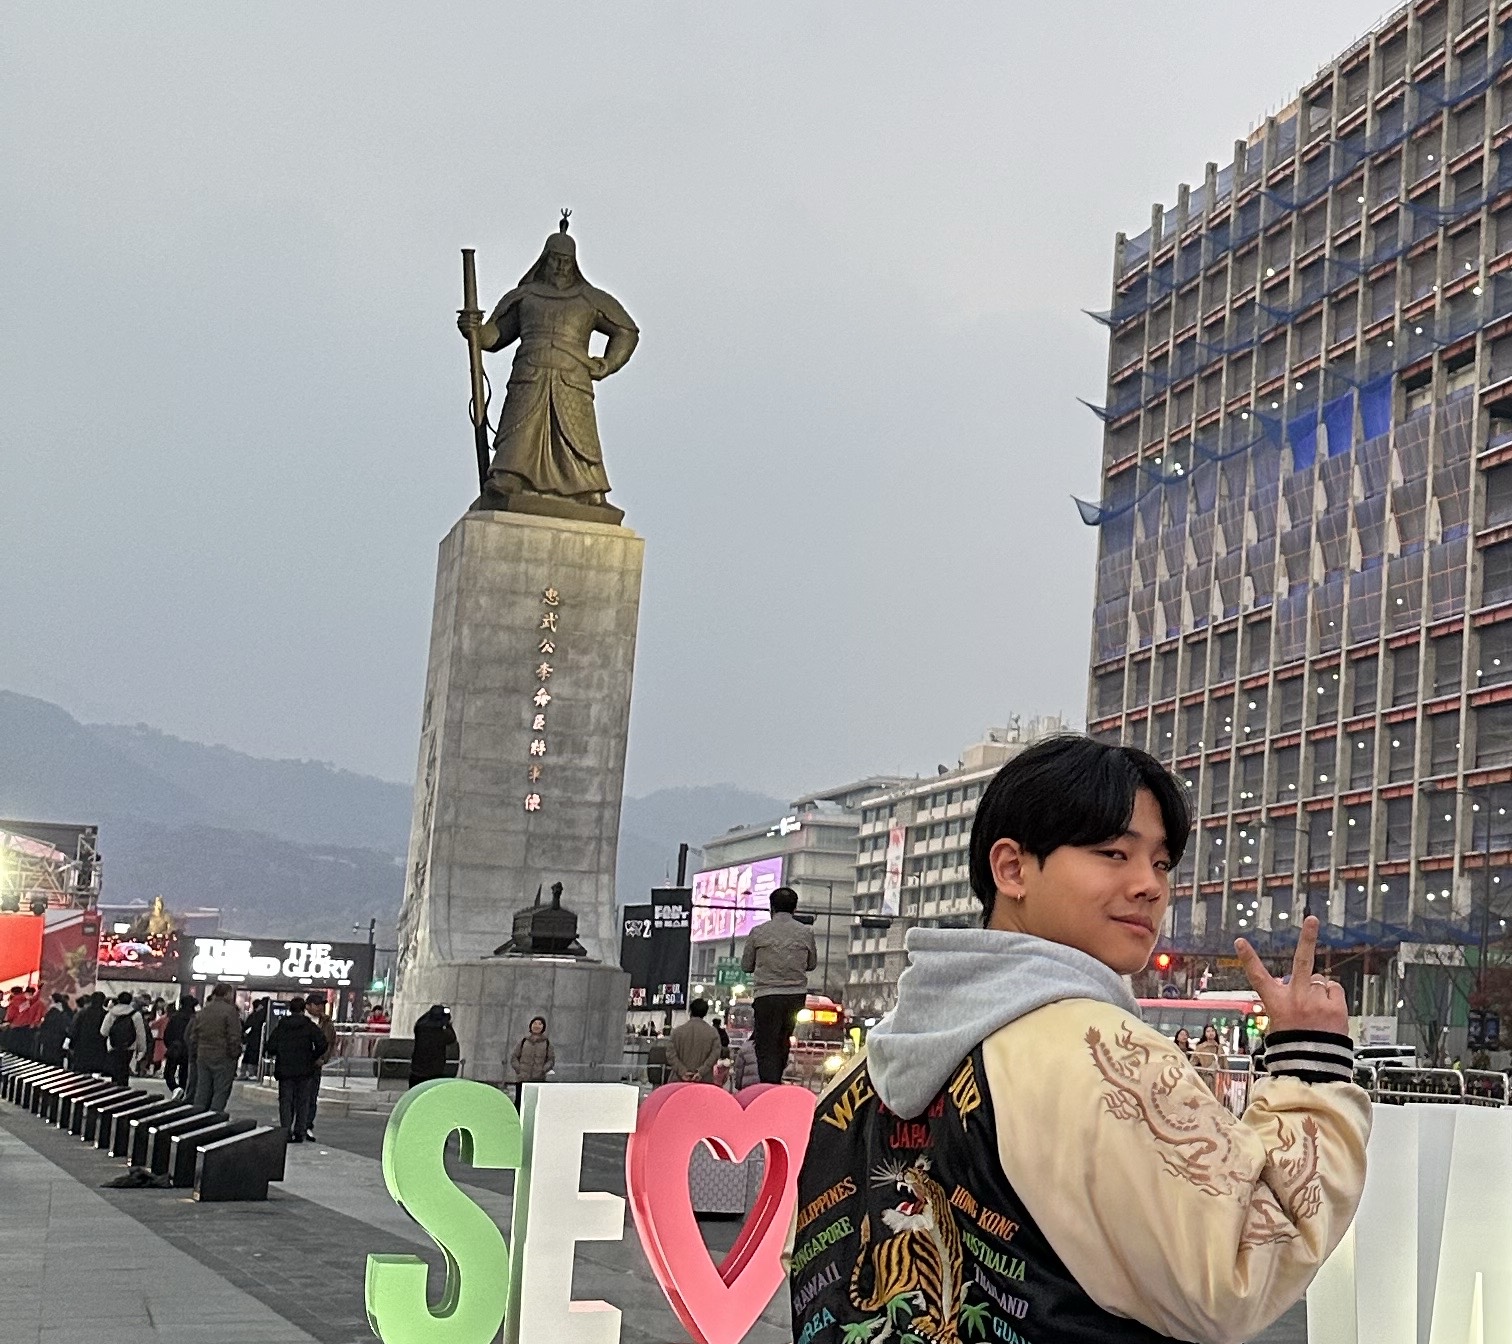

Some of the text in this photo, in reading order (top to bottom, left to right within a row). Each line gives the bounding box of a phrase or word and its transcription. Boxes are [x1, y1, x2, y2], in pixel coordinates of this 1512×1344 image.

[283, 942, 332, 960] THE
[282, 959, 354, 979] GLORY
[977, 1206, 1021, 1243] KONG
